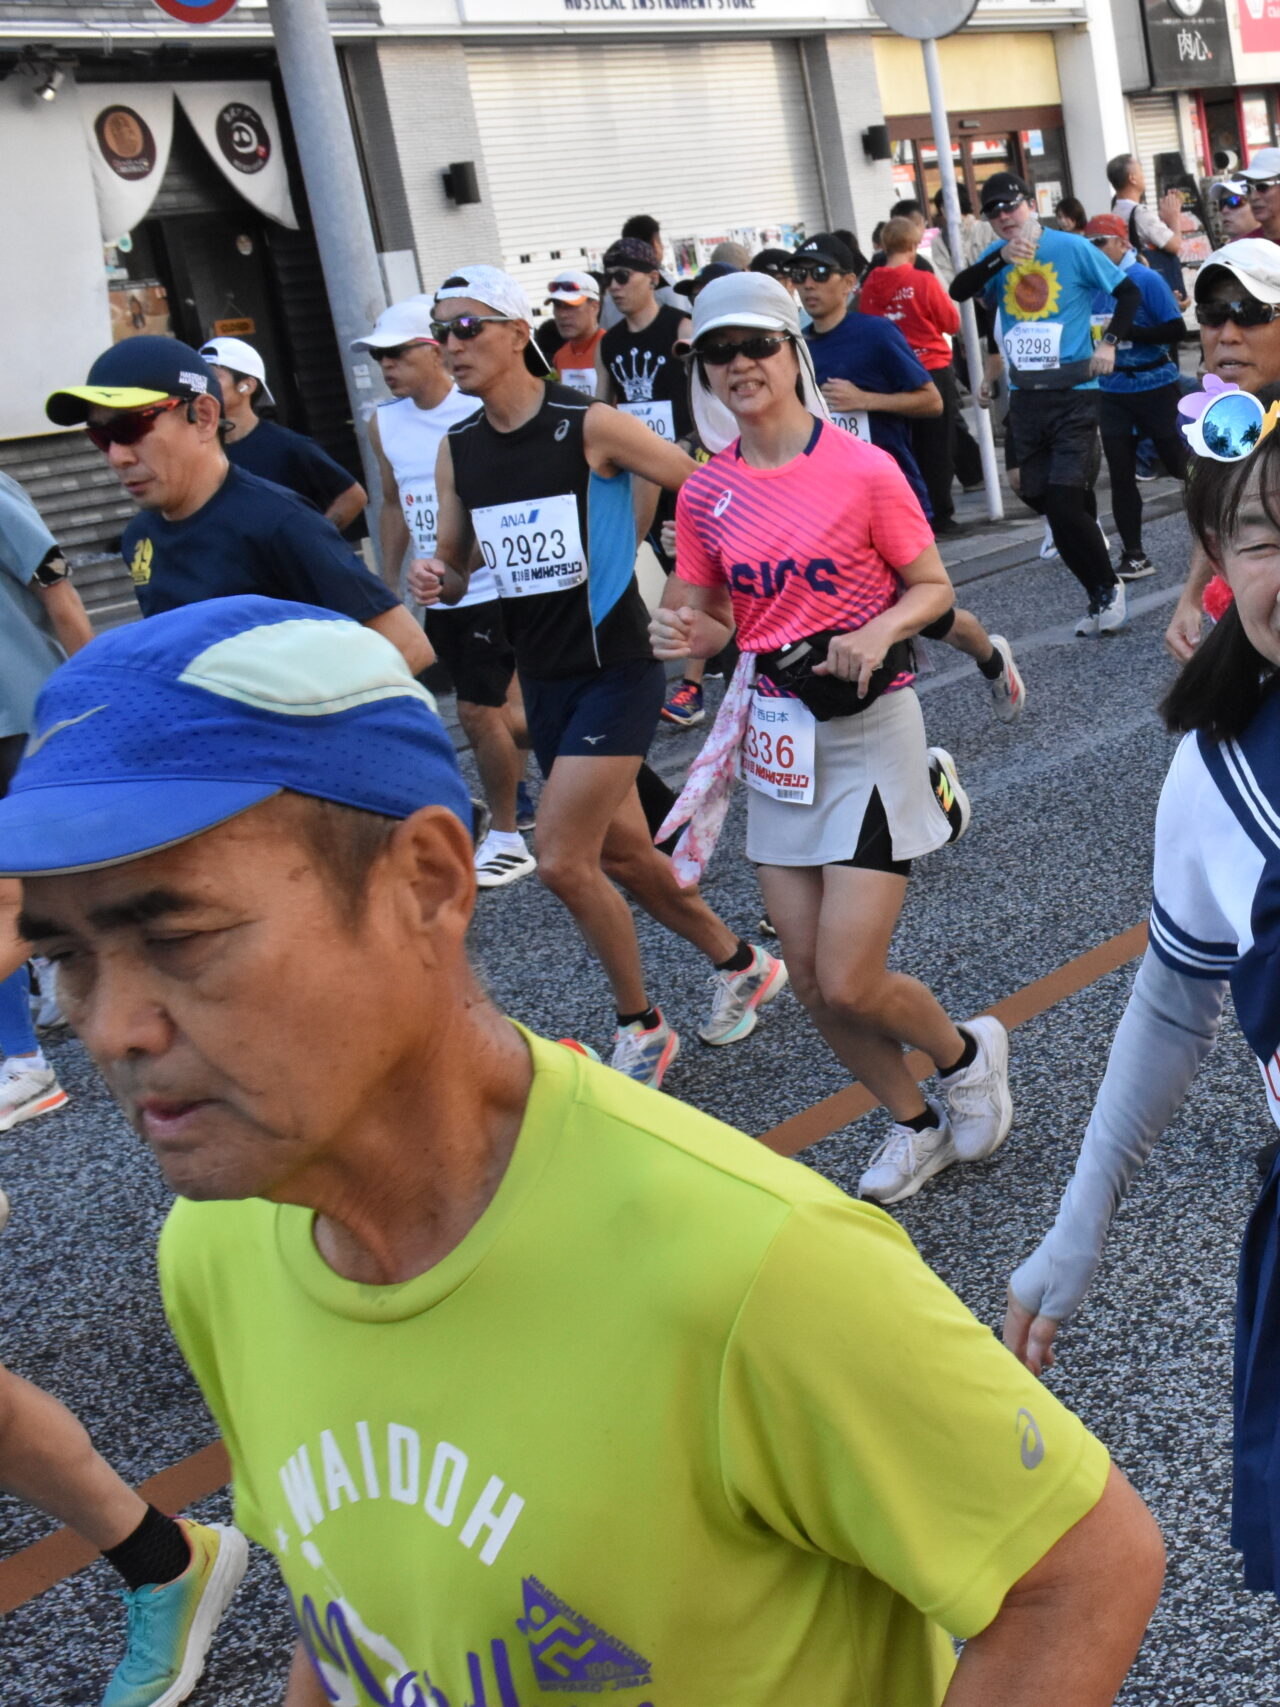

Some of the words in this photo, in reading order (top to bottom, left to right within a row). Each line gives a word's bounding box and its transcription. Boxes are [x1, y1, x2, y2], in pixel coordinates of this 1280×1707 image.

[1016, 337, 1052, 355] 3298
[415, 508, 435, 532] 49
[500, 512, 527, 529] ANA
[481, 540, 497, 570] D
[502, 529, 566, 568] 2923
[531, 560, 583, 581] NAHAマラソン
[728, 558, 839, 599] SICS
[747, 724, 795, 769] 336
[278, 1420, 526, 1566] WAIDOH
